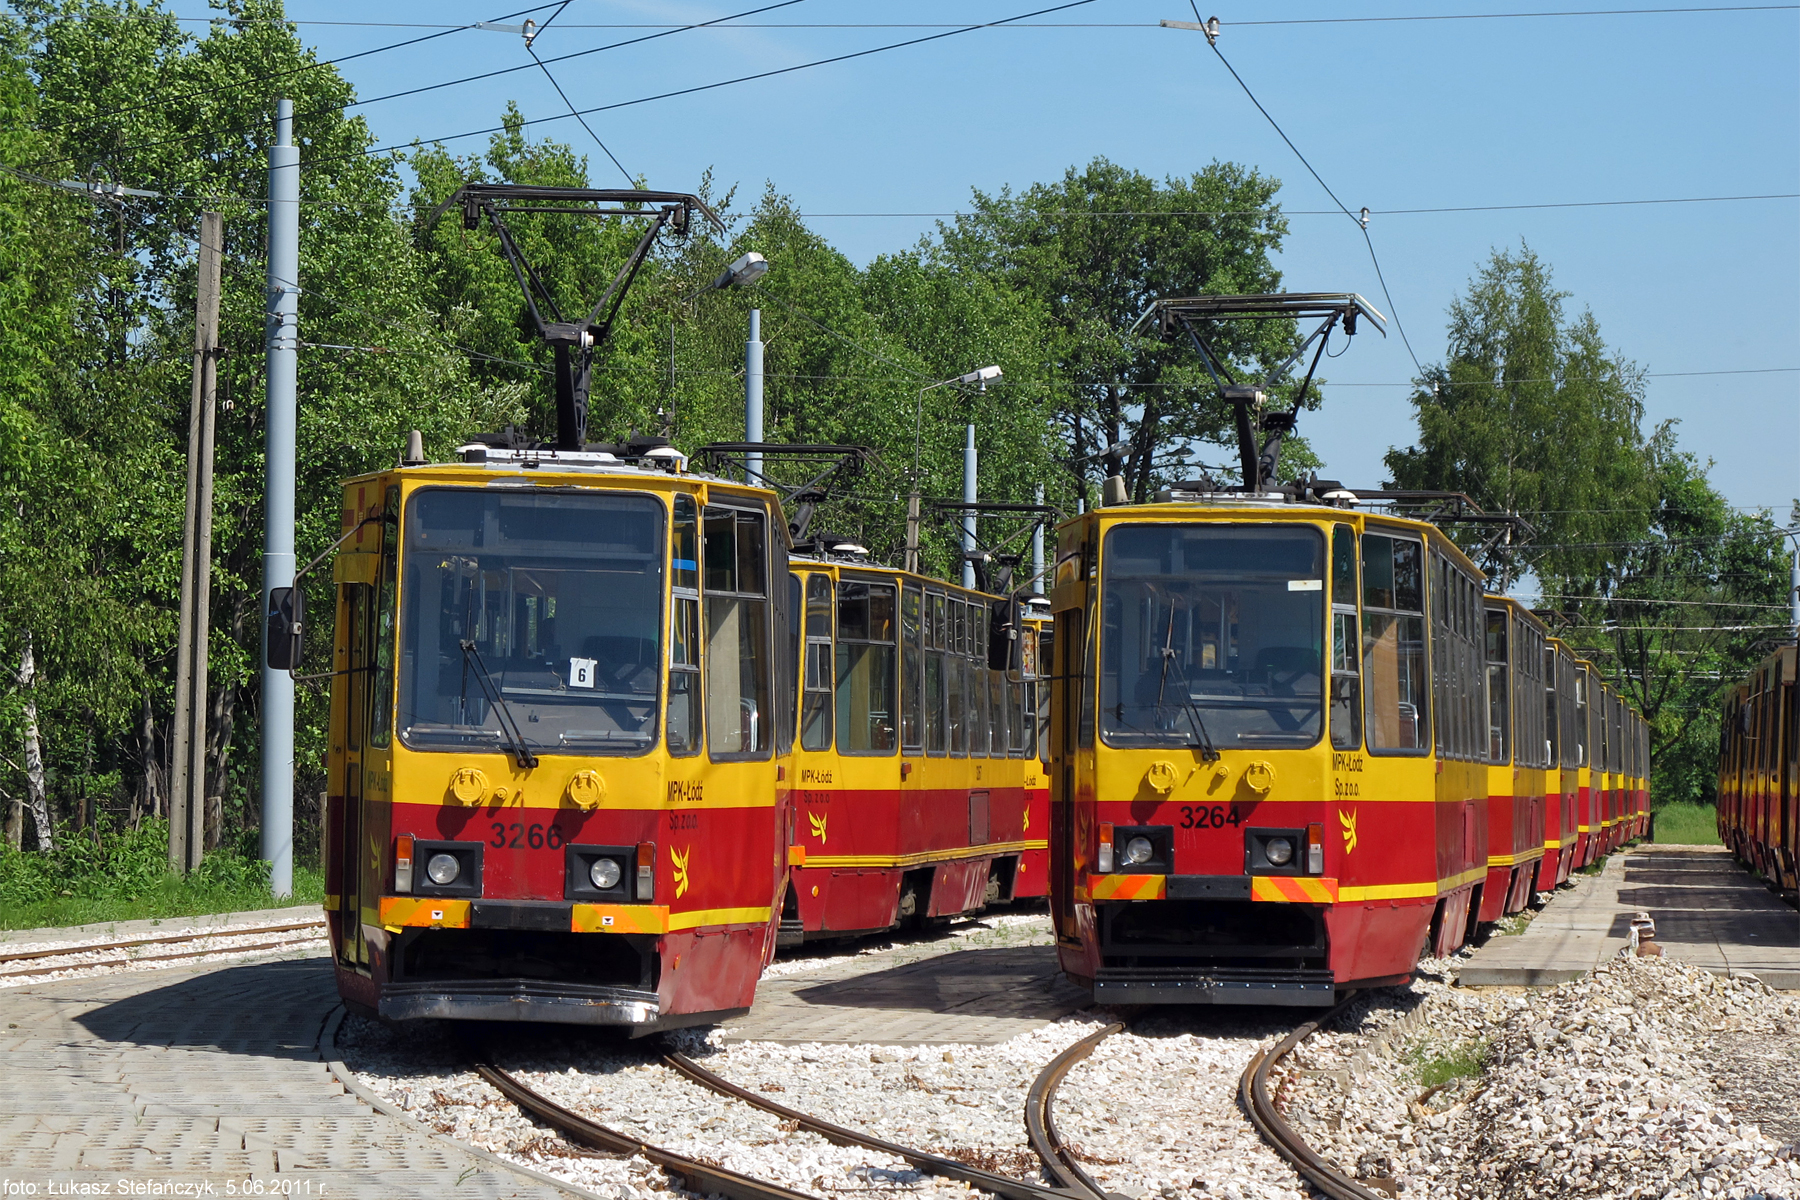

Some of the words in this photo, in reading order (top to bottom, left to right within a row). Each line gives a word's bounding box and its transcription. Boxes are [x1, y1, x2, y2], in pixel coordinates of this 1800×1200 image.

[578, 668, 586, 683] 6
[1180, 805, 1241, 829] 3264
[490, 822, 563, 850] 3266
